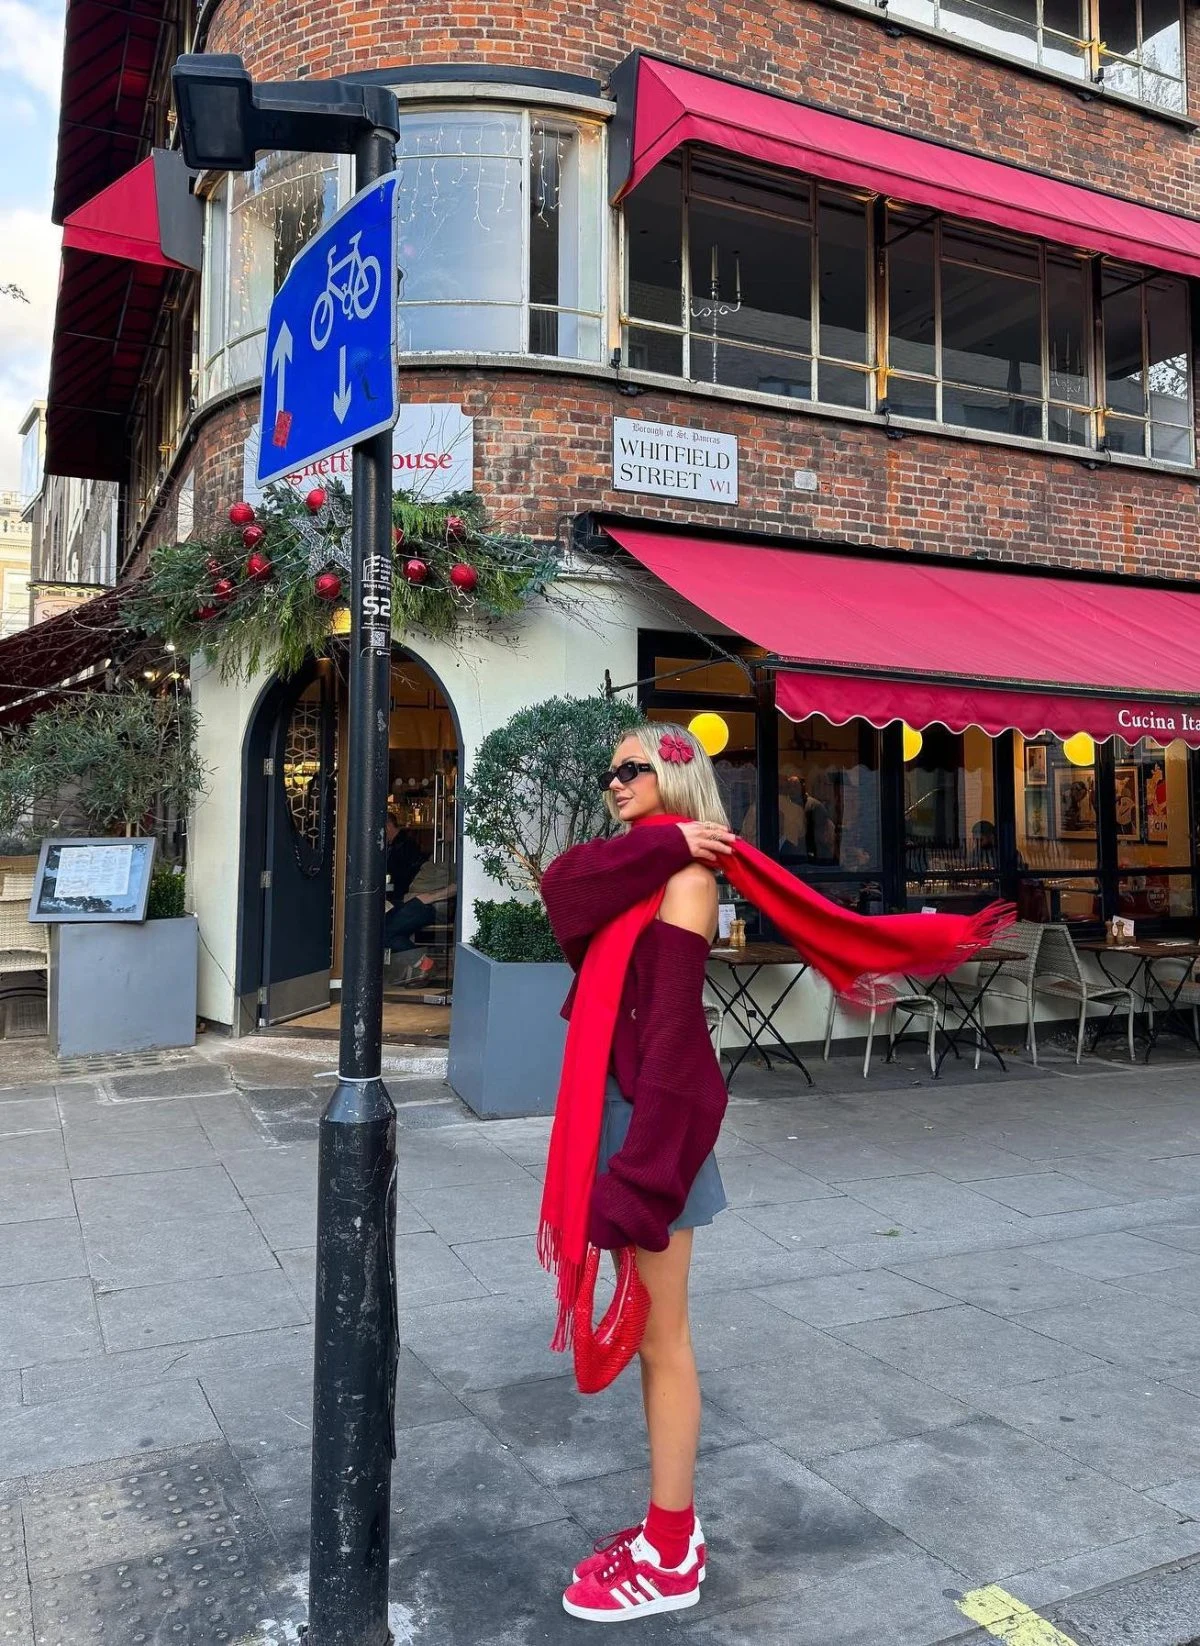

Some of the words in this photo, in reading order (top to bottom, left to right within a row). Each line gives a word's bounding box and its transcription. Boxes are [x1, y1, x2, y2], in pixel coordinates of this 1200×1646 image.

[632, 422, 664, 437] Borough
[666, 428, 673, 437] of
[676, 430, 689, 440] St.
[692, 432, 721, 445] Pancras
[392, 453, 453, 470] ouse
[620, 437, 730, 470] WHITFIELD
[620, 462, 702, 490] STREET
[709, 478, 731, 495] W1
[1118, 709, 1176, 730] Cucina
